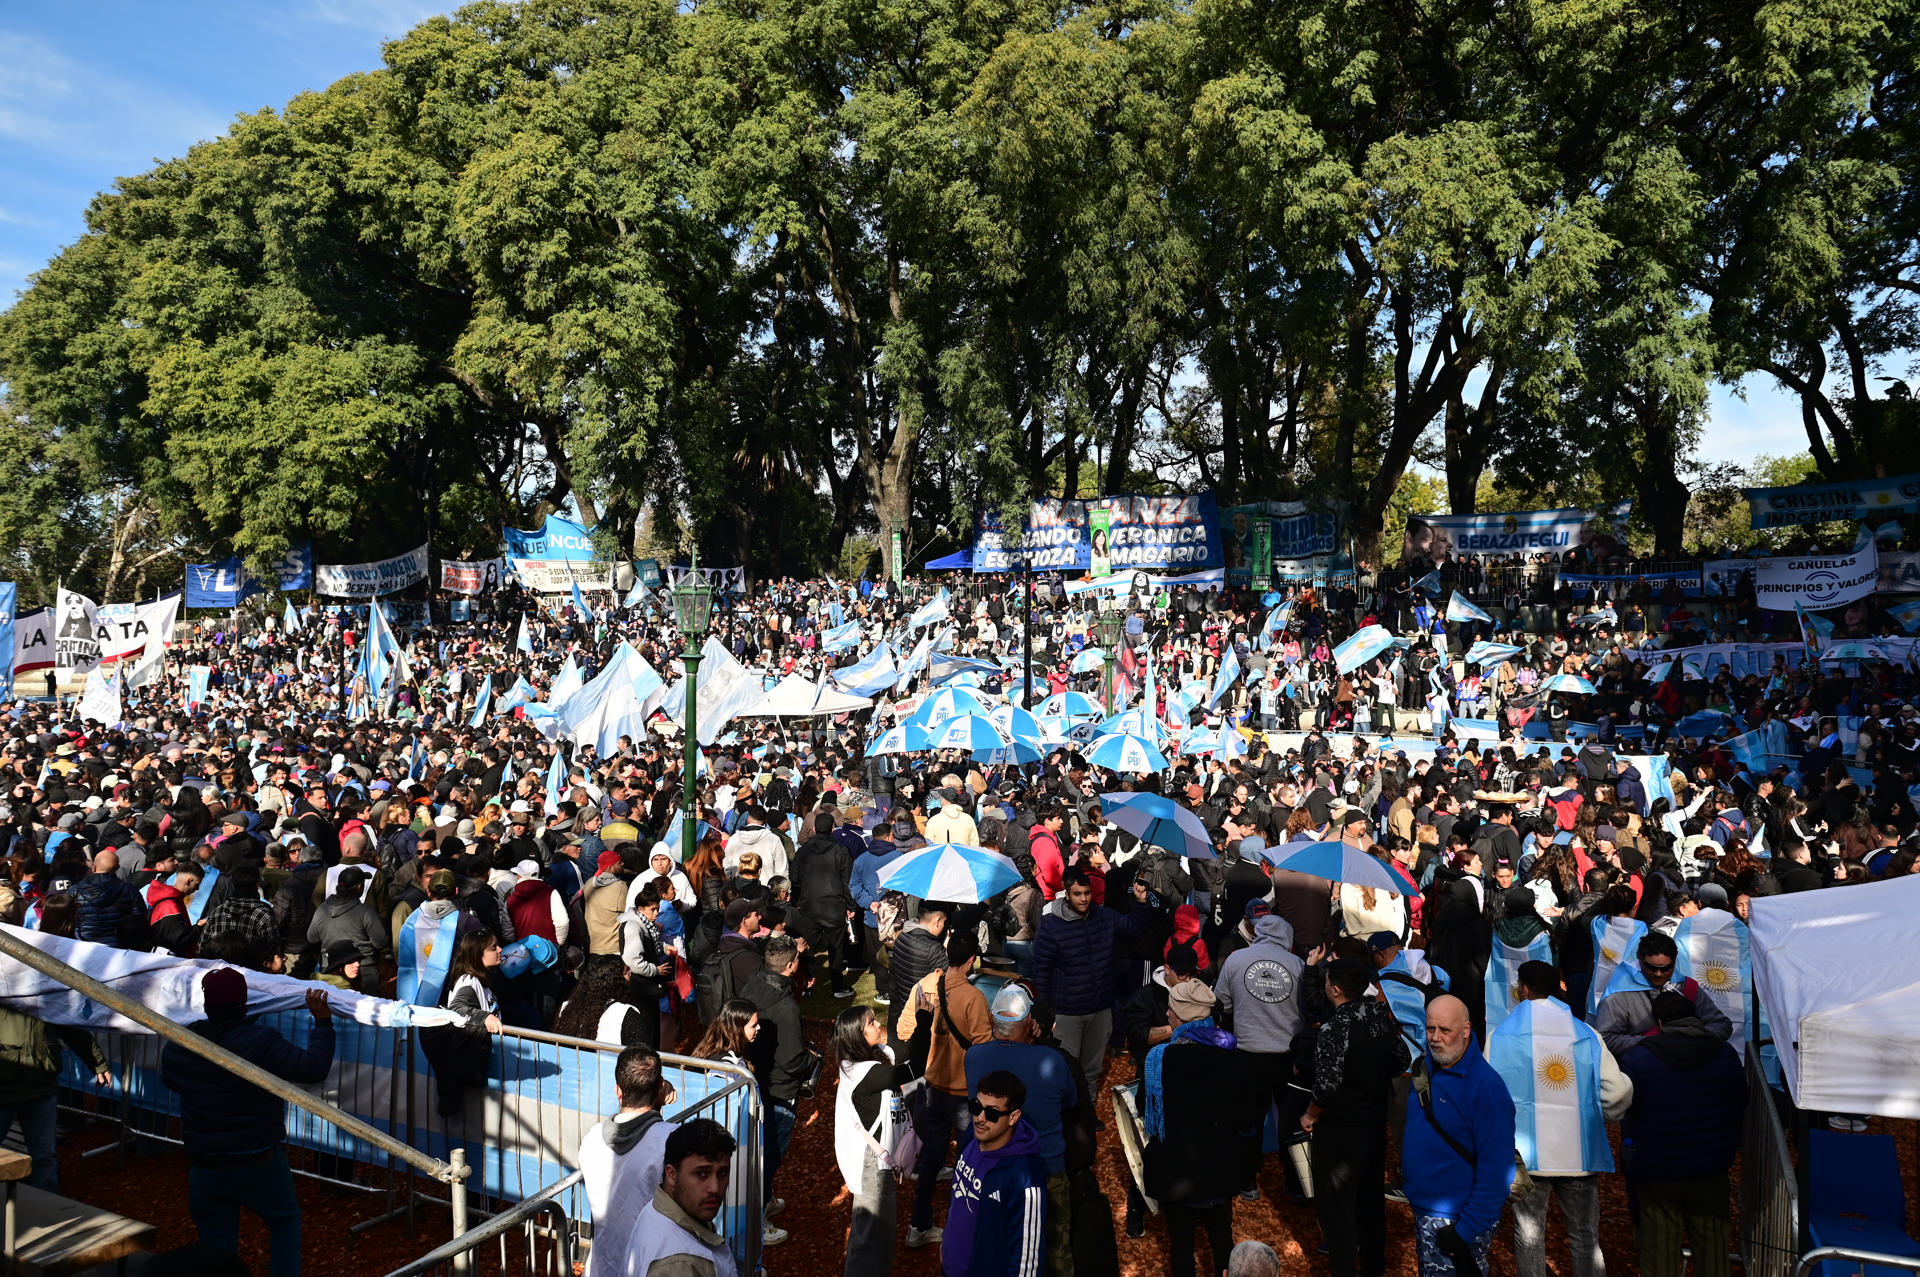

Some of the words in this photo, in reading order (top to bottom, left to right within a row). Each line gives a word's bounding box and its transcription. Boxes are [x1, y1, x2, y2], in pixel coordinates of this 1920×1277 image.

[1770, 489, 1865, 509] CRISTINA
[1767, 509, 1855, 526] INOCENTE
[512, 541, 548, 554] NUEV
[979, 528, 1082, 550] FENANDO
[1458, 532, 1569, 549] BERAZATEGUI
[1110, 546, 1208, 565] MAGARIO
[1788, 557, 1856, 570] CAÑUELAS
[1757, 583, 1823, 594] PRINCIPIOS
[1826, 582, 1835, 591] Y
[1838, 568, 1881, 589] VALORES
[22, 628, 47, 649] LA
[1247, 962, 1290, 984] QUIKSILVER
